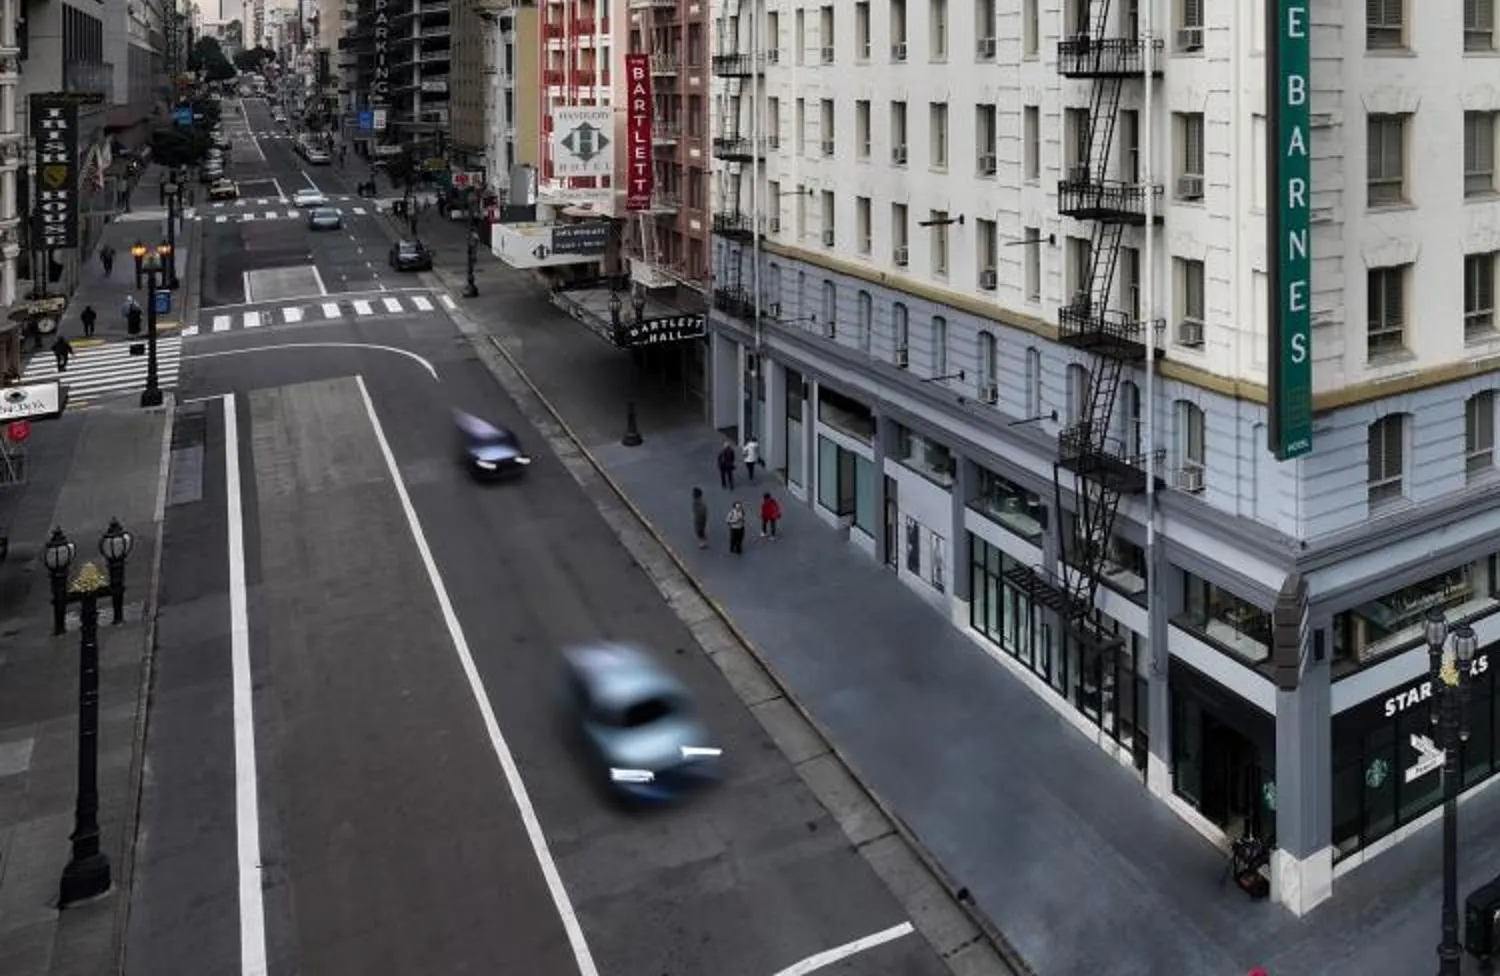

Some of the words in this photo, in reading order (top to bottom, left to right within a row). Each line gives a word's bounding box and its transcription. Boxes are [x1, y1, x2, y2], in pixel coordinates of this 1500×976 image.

[375, 0, 389, 93] PARKING
[632, 67, 647, 192] BARTLETT
[1287, 74, 1307, 364] BARNES
[649, 331, 681, 343] HALL
